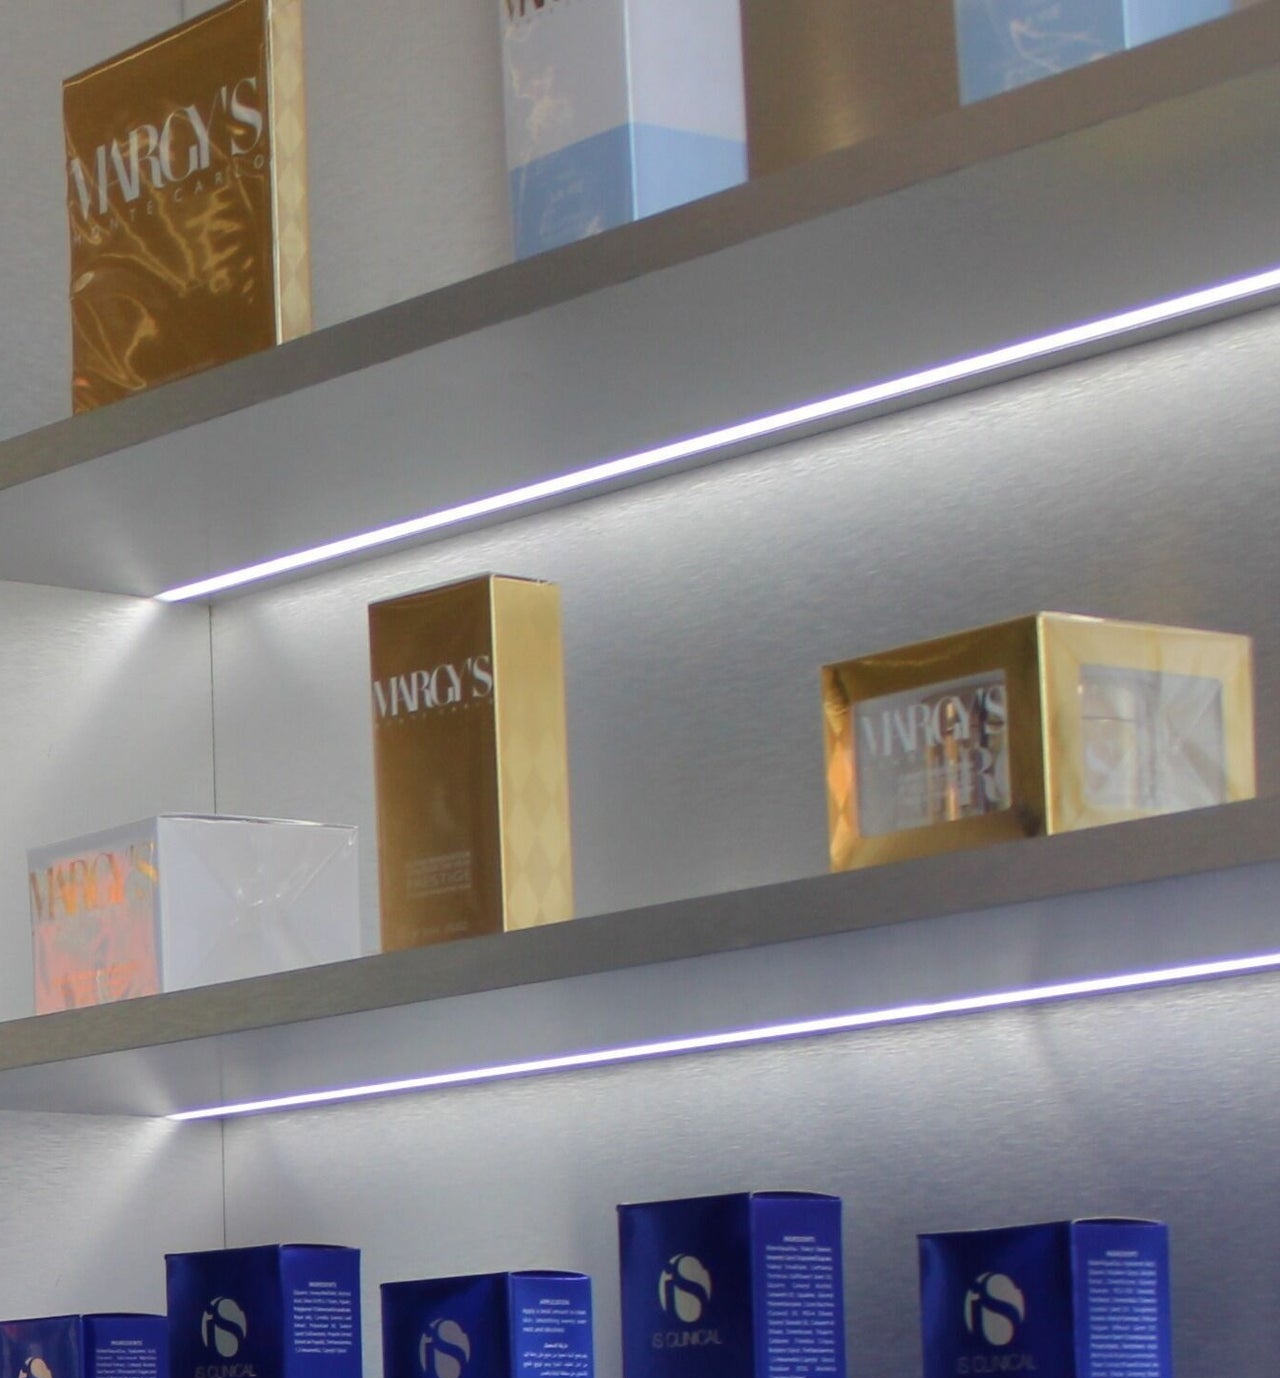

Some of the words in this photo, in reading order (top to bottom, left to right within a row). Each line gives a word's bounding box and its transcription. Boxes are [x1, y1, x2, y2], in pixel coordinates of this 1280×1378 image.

[70, 77, 263, 222] MARGY'S
[373, 655, 494, 720] MARGY'S
[860, 686, 1007, 756] MARGY'S
[667, 1328, 724, 1347] CLINICAL
[210, 1363, 257, 1378] CLINICAL
[971, 1354, 1038, 1372] CLINICAL
